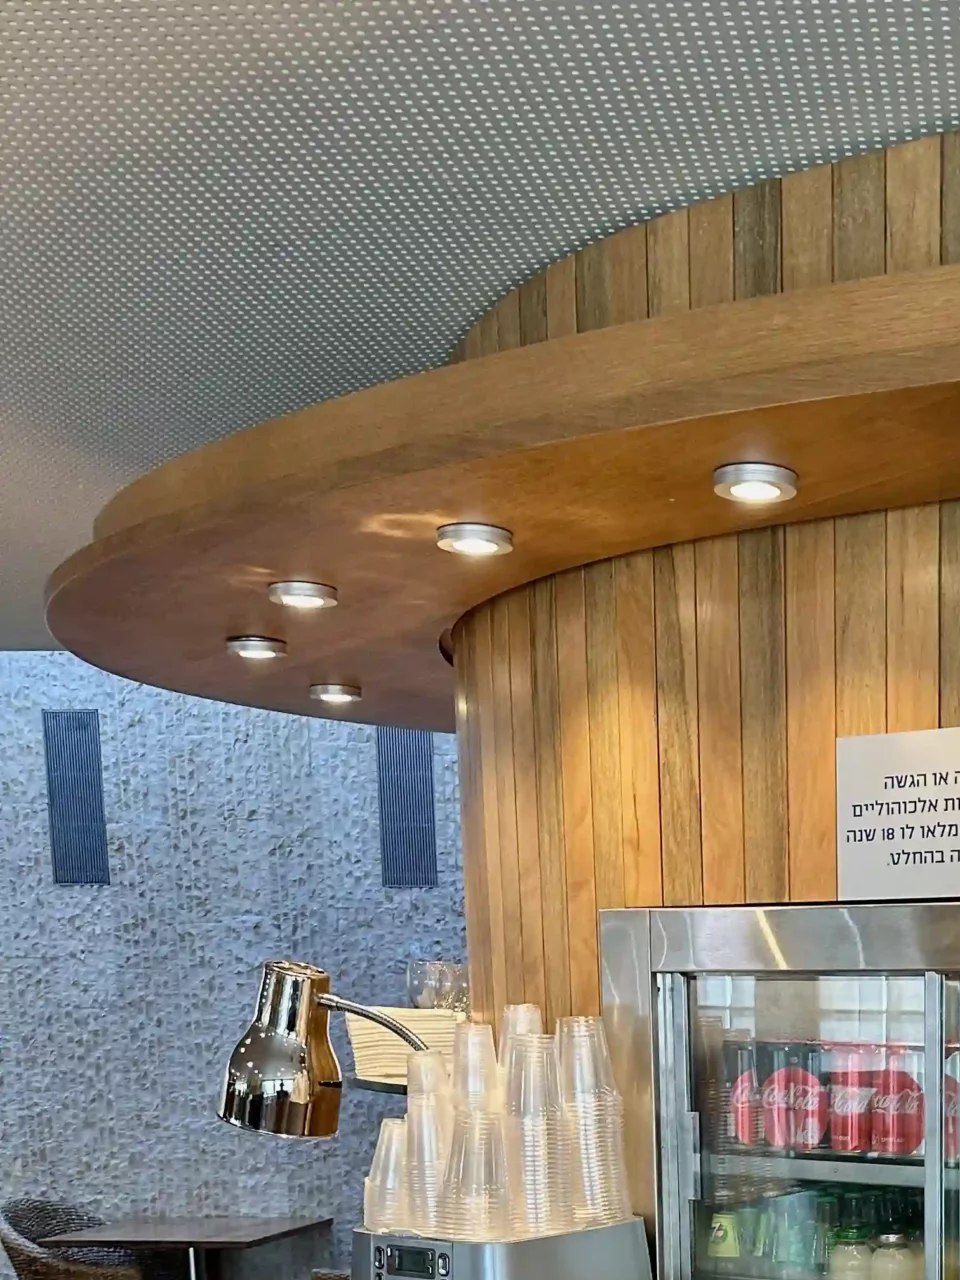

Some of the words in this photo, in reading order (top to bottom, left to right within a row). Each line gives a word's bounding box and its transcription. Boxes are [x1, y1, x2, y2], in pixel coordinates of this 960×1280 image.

[883, 773, 928, 791] הגשה
[931, 771, 950, 787] או
[851, 796, 939, 818] אלכוהוליים
[846, 827, 877, 844] שנה
[880, 827, 896, 842] 18
[899, 823, 916, 841] לו
[919, 821, 959, 840] מלאו
